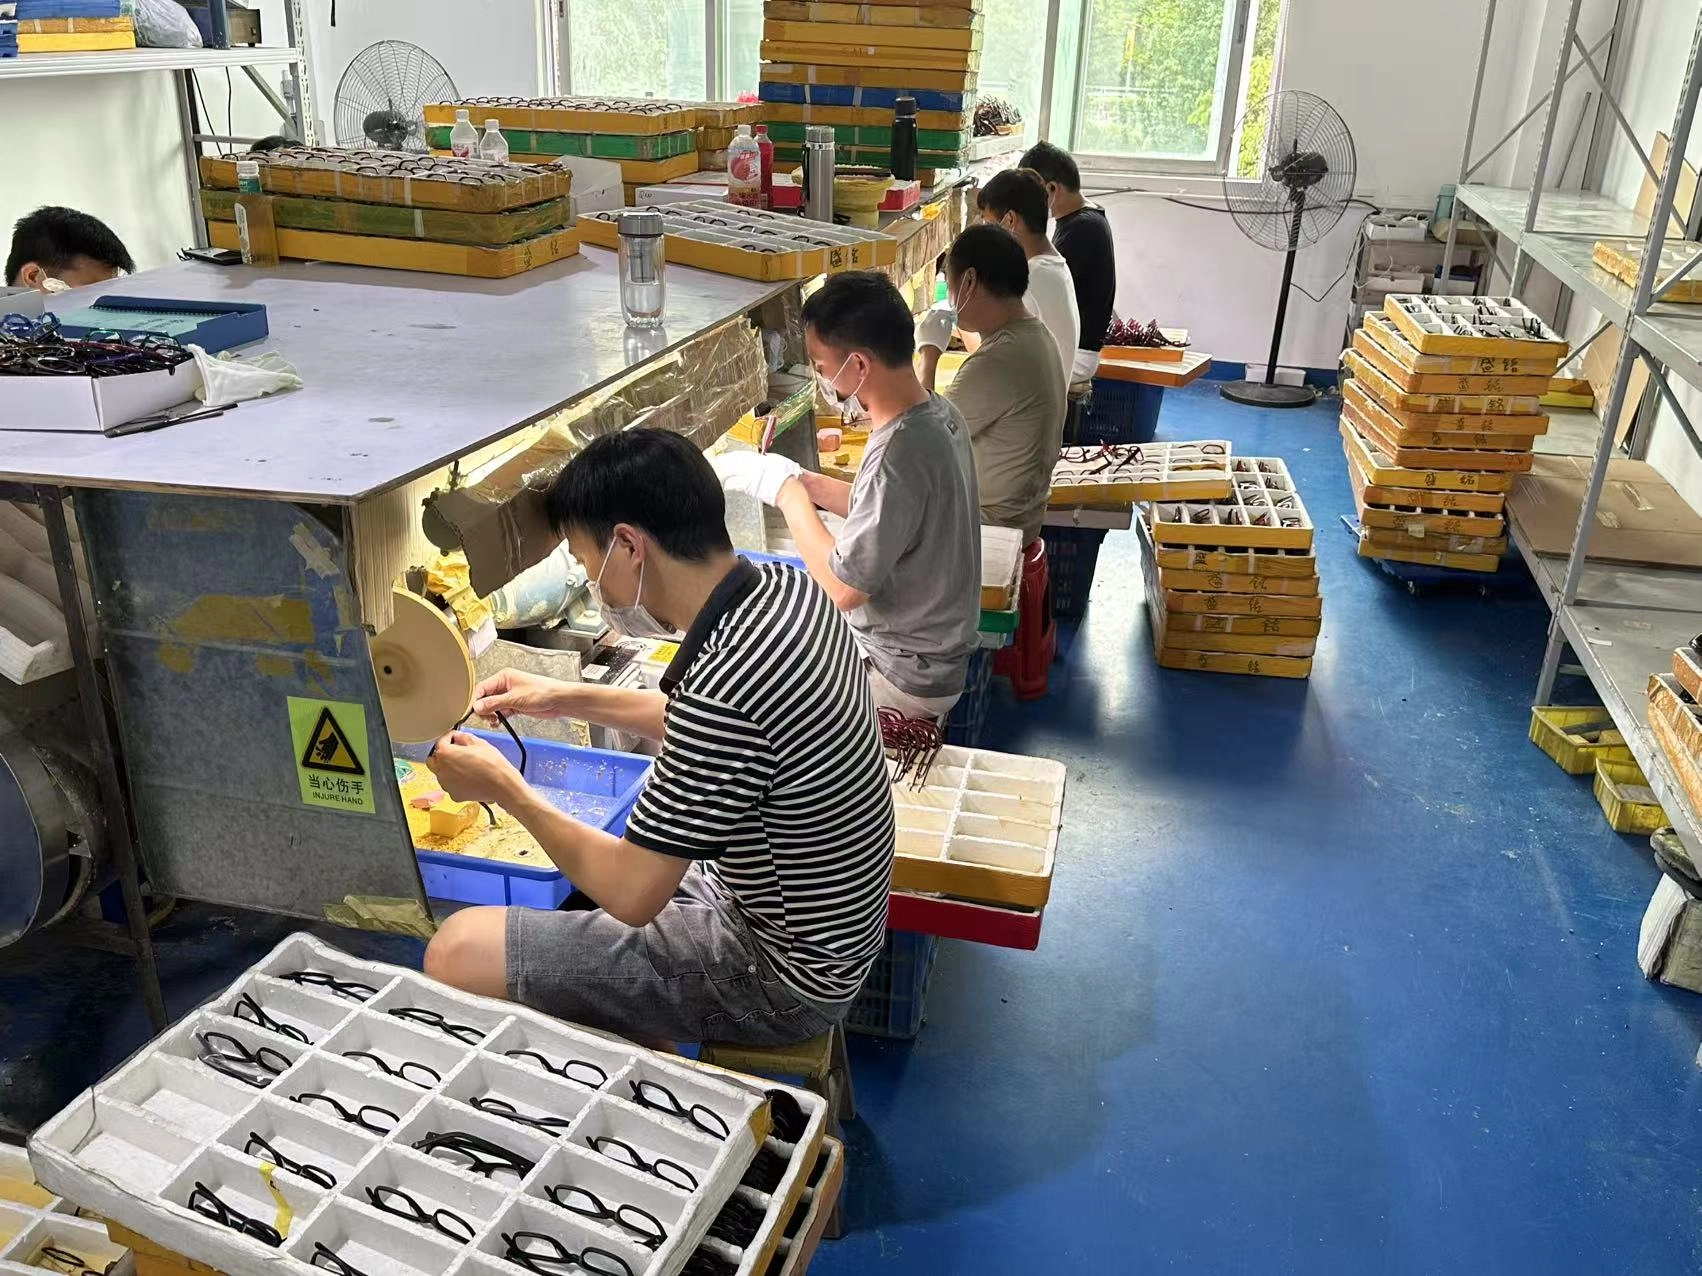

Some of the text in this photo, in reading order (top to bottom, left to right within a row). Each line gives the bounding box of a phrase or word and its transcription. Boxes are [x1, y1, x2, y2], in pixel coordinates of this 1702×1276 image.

[308, 773, 365, 795] 当心伤手
[312, 791, 363, 805] INJURE HAND
